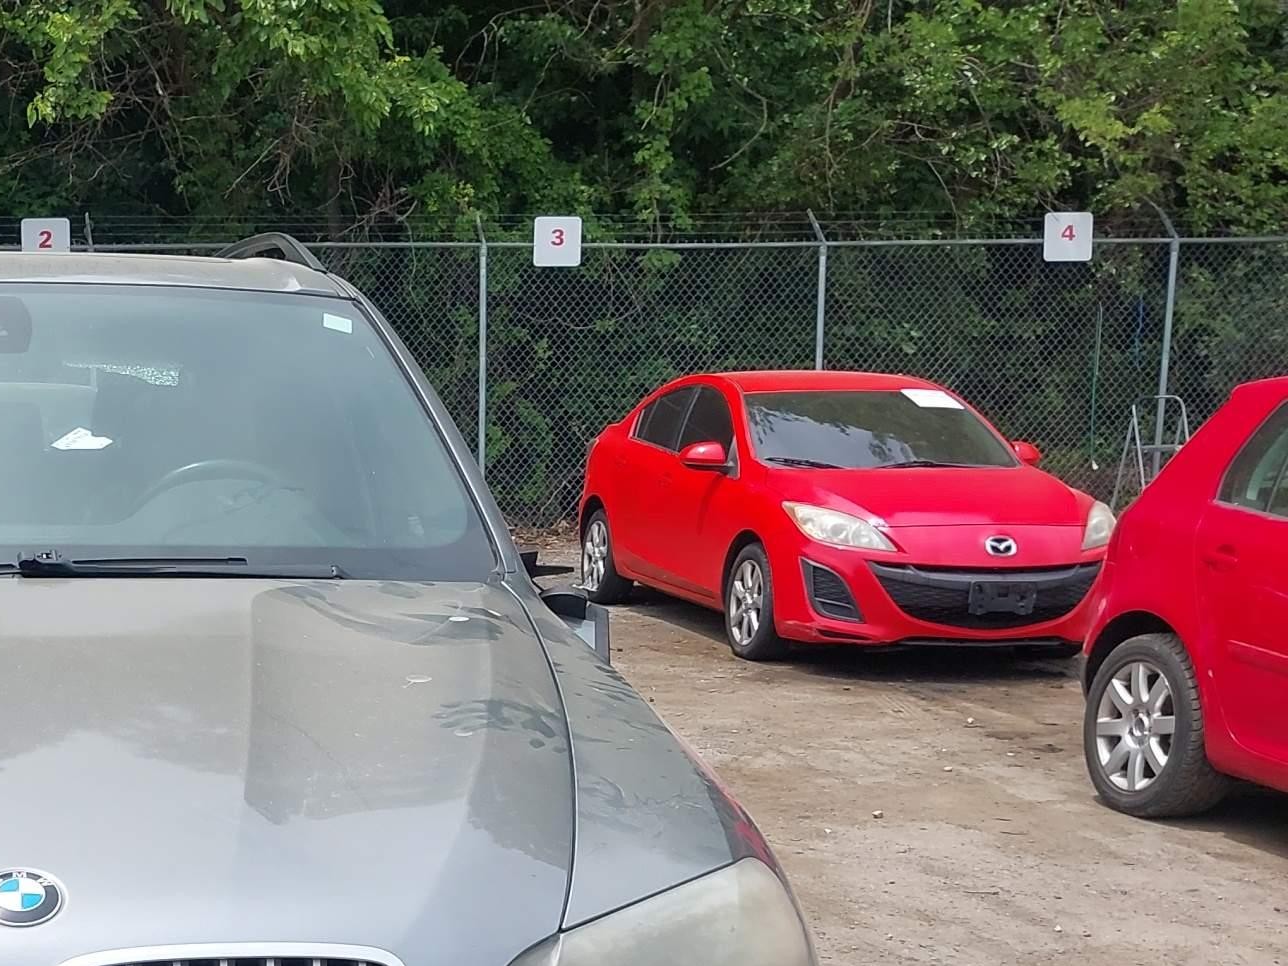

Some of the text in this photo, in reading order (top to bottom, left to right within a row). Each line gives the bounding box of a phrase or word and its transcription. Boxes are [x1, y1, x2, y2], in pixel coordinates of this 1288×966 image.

[38, 230, 53, 249] 2
[550, 229, 565, 246] 3
[1061, 224, 1076, 241] 4
